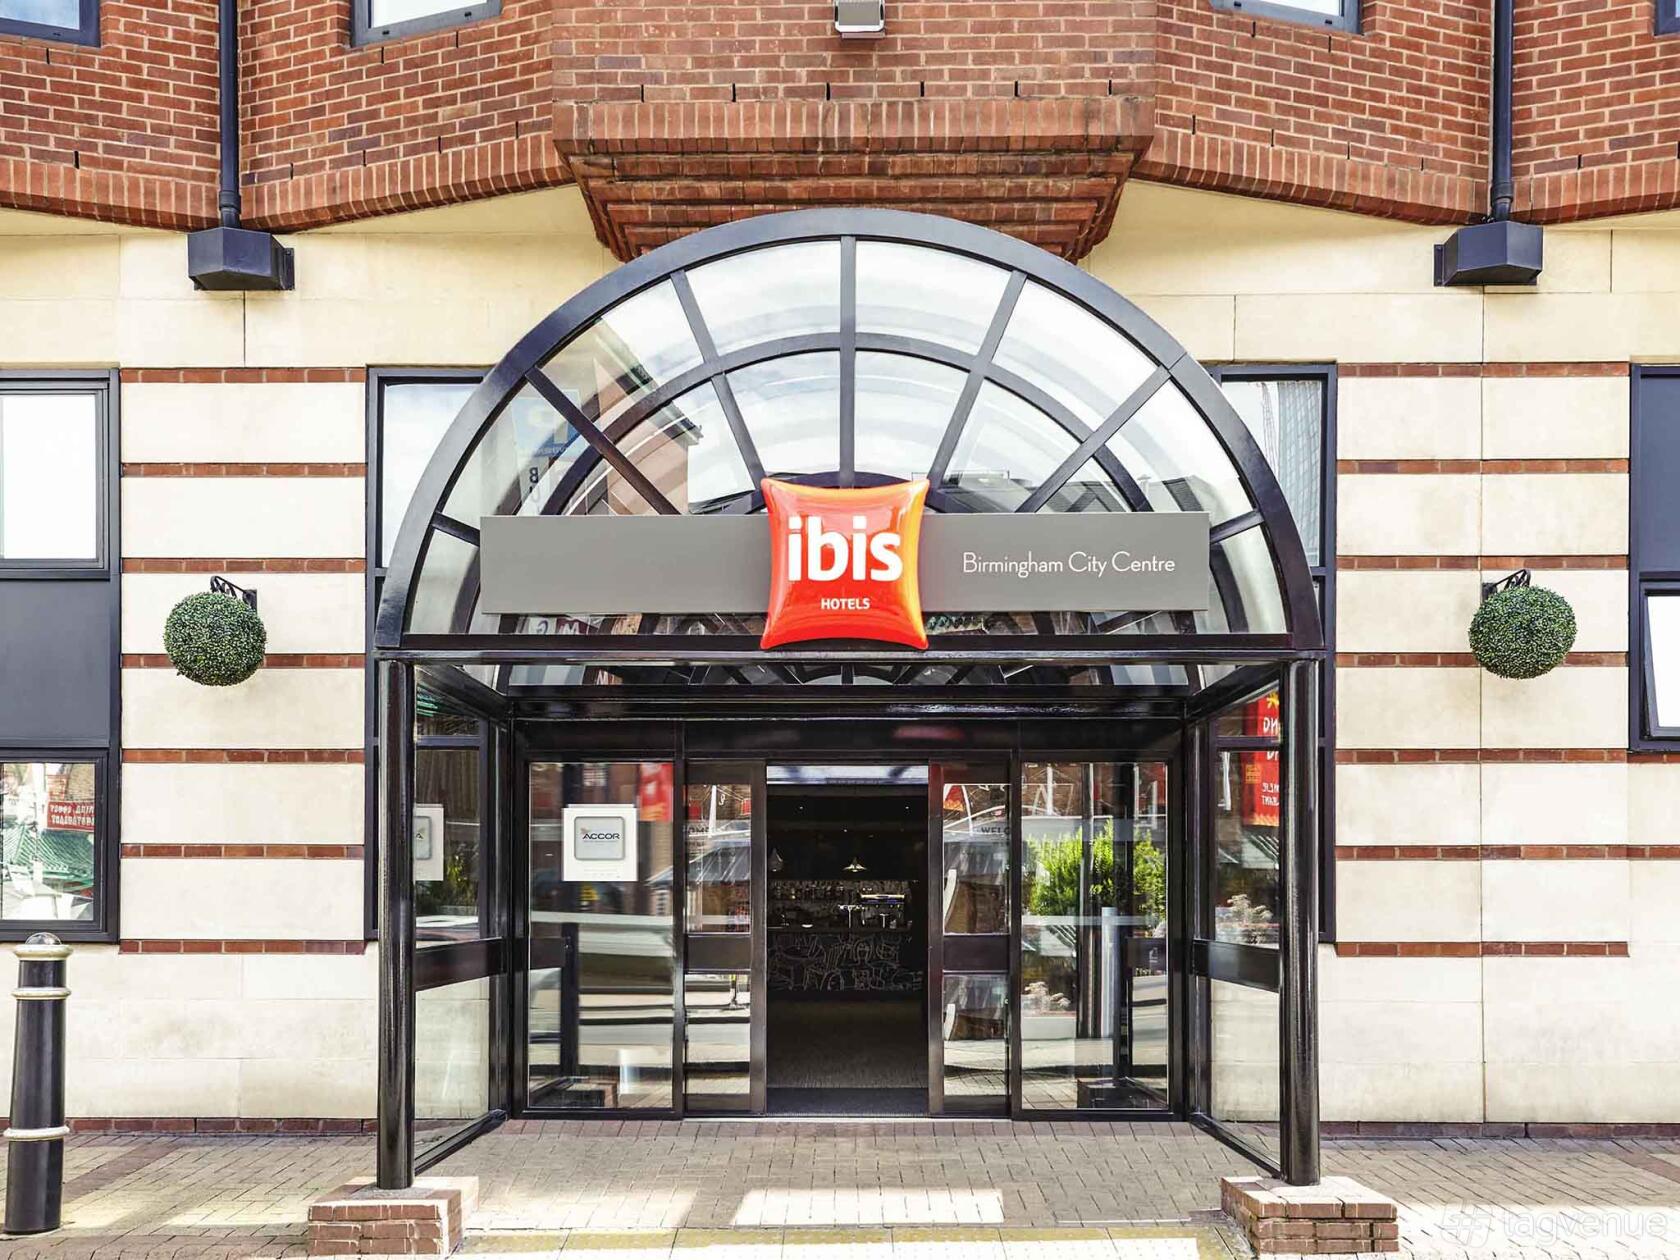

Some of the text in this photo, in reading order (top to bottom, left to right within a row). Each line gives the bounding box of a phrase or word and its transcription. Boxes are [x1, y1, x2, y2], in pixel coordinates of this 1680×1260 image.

[788, 515, 904, 582] ibis
[963, 551, 1176, 578] Birmingham City Centre
[821, 598, 871, 610] HOTELS
[582, 832, 620, 840] ACCOR
